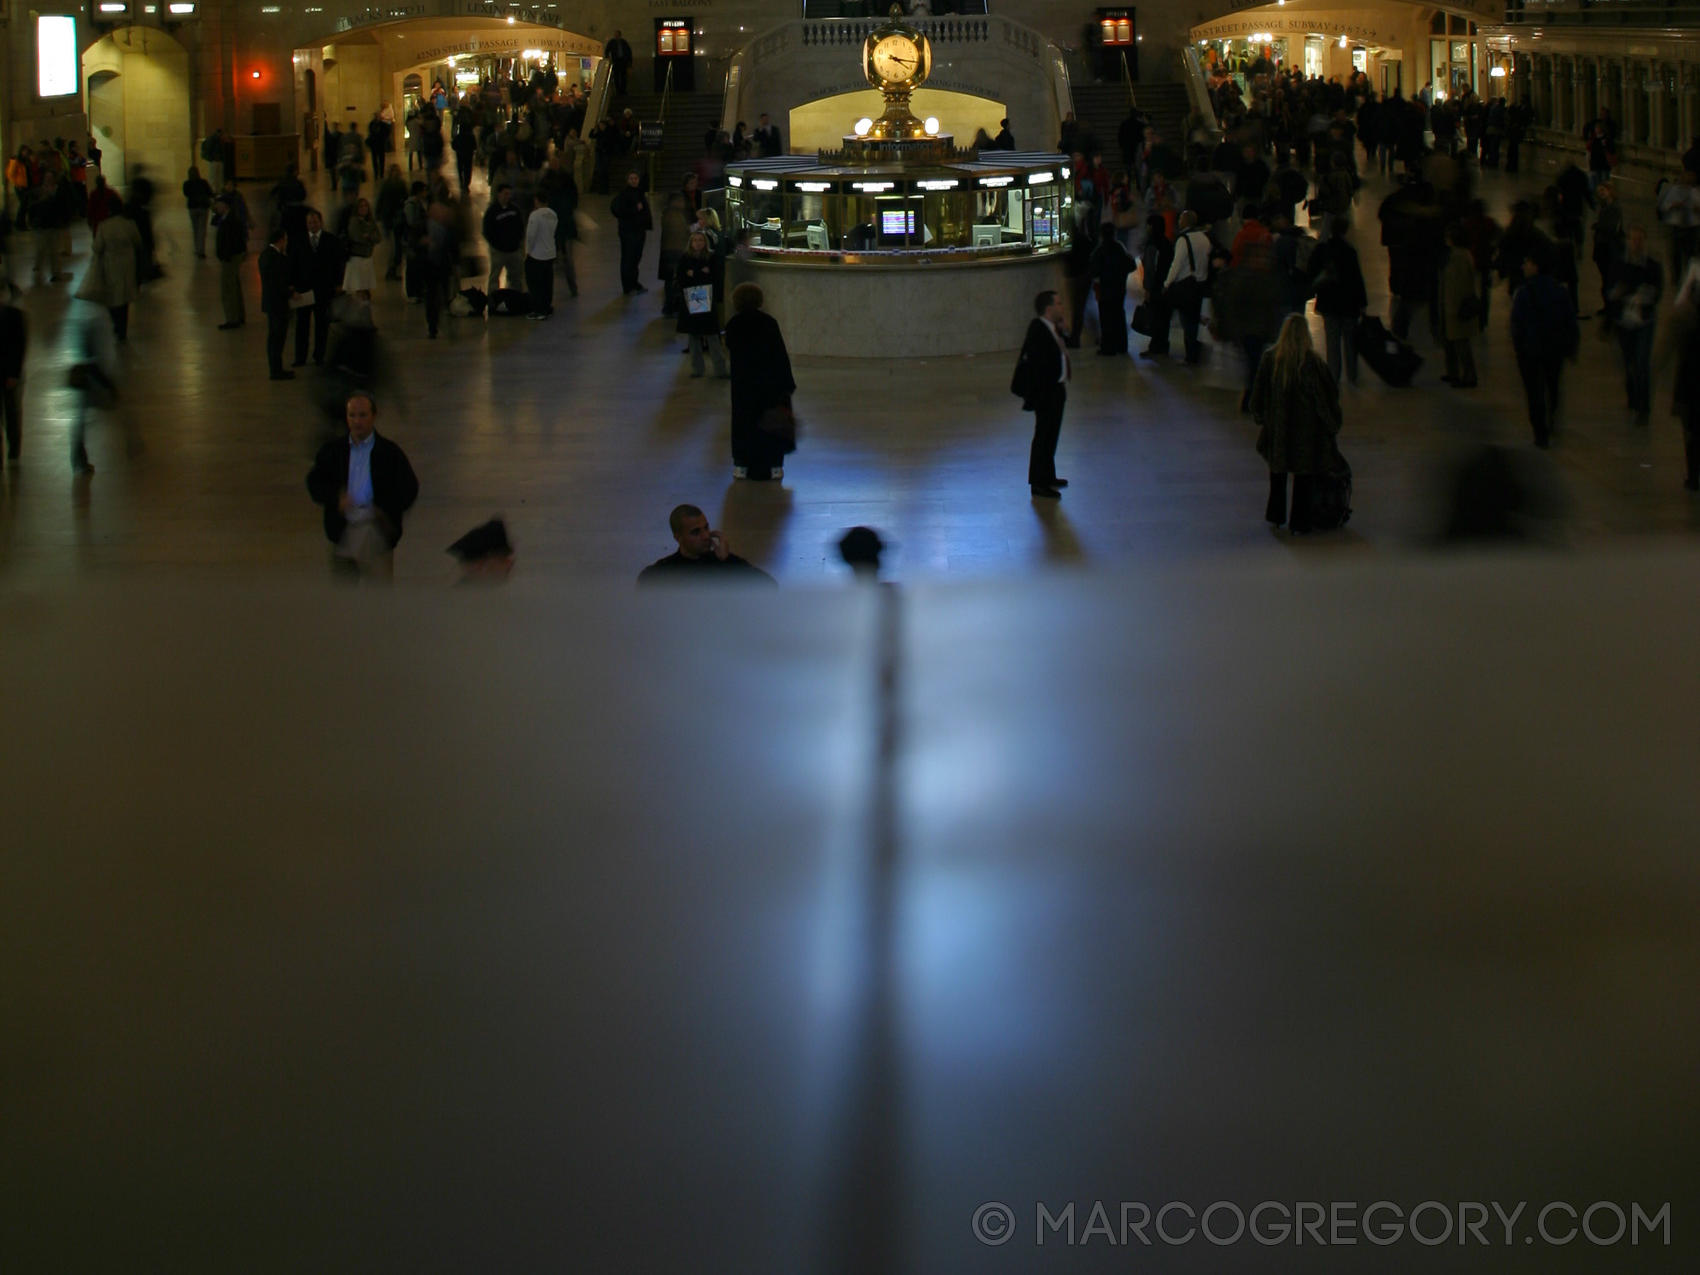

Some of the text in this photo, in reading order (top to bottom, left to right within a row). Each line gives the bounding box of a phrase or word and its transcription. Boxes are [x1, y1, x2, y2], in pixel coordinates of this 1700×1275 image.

[648, 0, 669, 8] EAST
[466, 3, 562, 23] LEXINGTON AVE
[1203, 23, 1240, 36] STREET
[1242, 20, 1285, 31] PASSAGE
[1288, 20, 1330, 30] SUBWAY
[442, 42, 477, 53] STREET
[479, 38, 520, 49] PASSAGE
[527, 38, 568, 48] SUBWAY
[880, 140, 933, 152] Information
